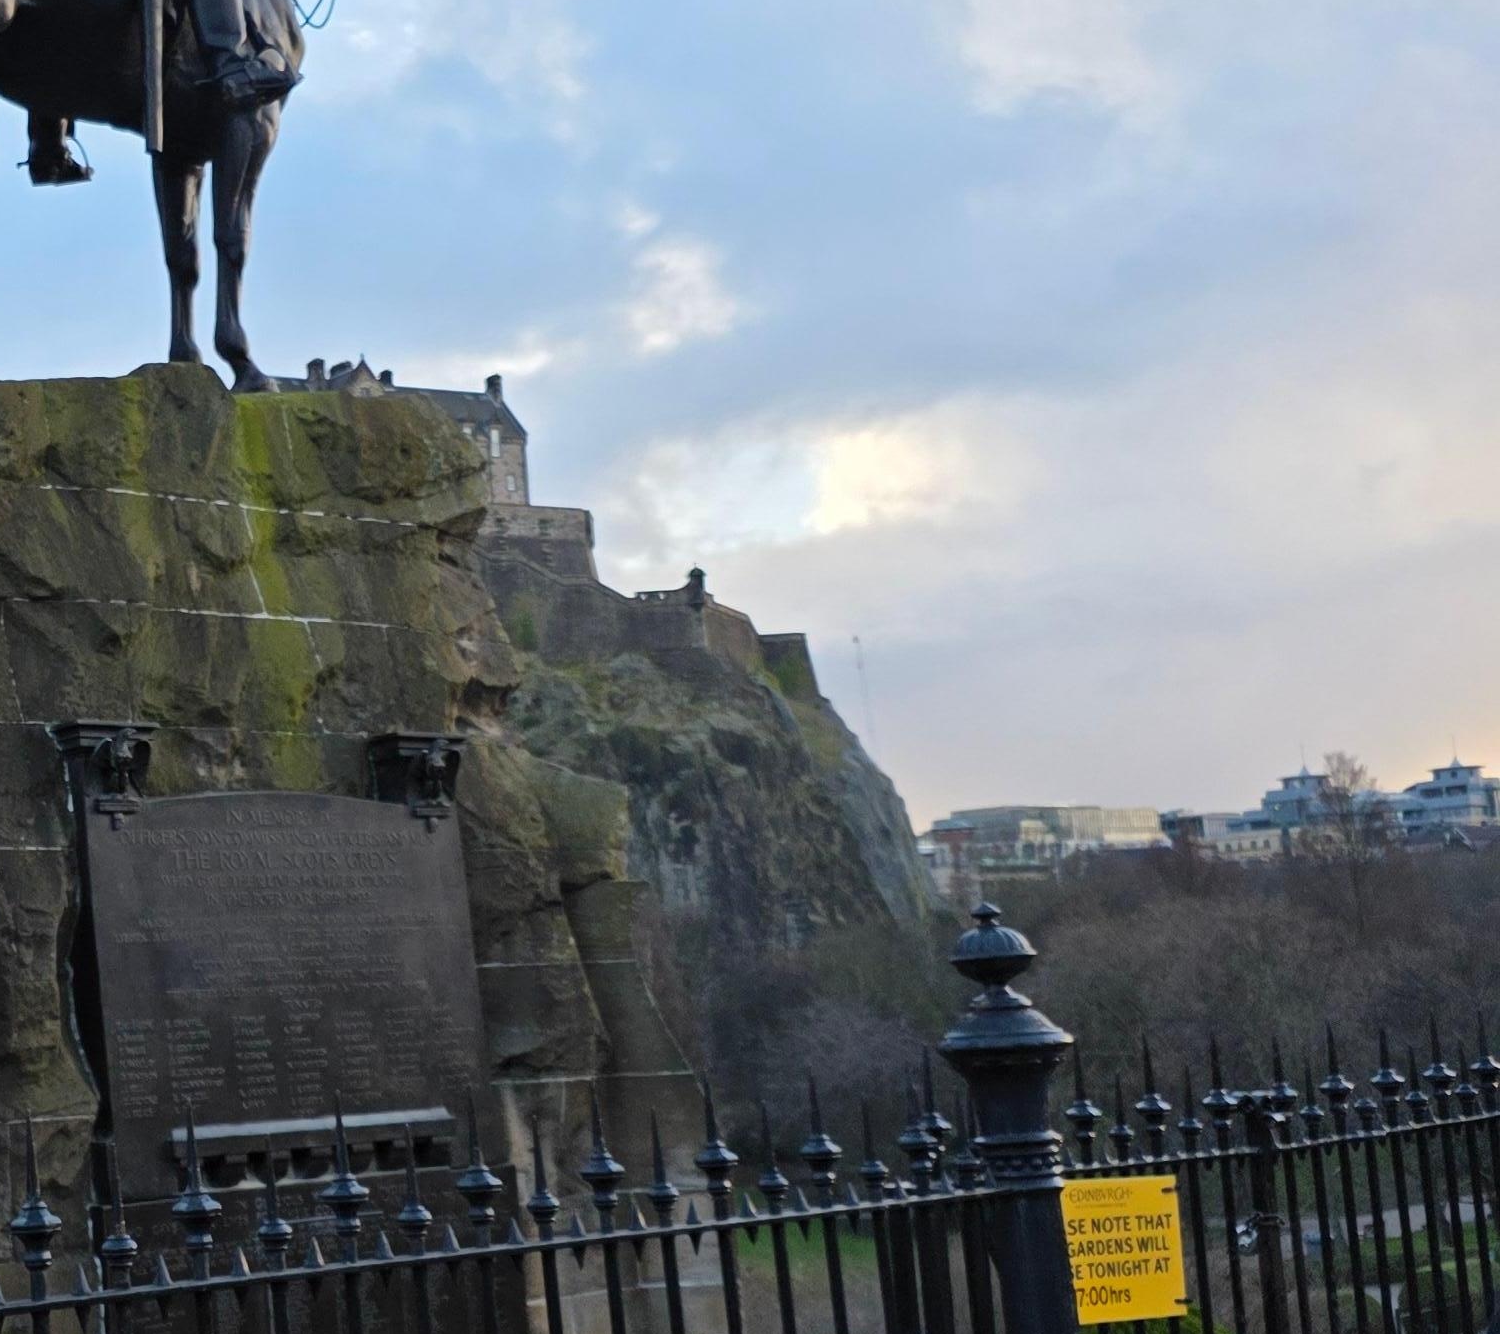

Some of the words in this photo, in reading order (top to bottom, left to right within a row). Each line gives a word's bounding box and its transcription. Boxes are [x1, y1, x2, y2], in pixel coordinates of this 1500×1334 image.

[1091, 1216, 1131, 1234] NOTE
[1135, 1214, 1172, 1231] THAT
[1068, 1237, 1133, 1259] GARDENS
[1137, 1235, 1170, 1253] WILL
[1087, 1259, 1150, 1279] TONIGHT
[1154, 1257, 1170, 1275] AT
